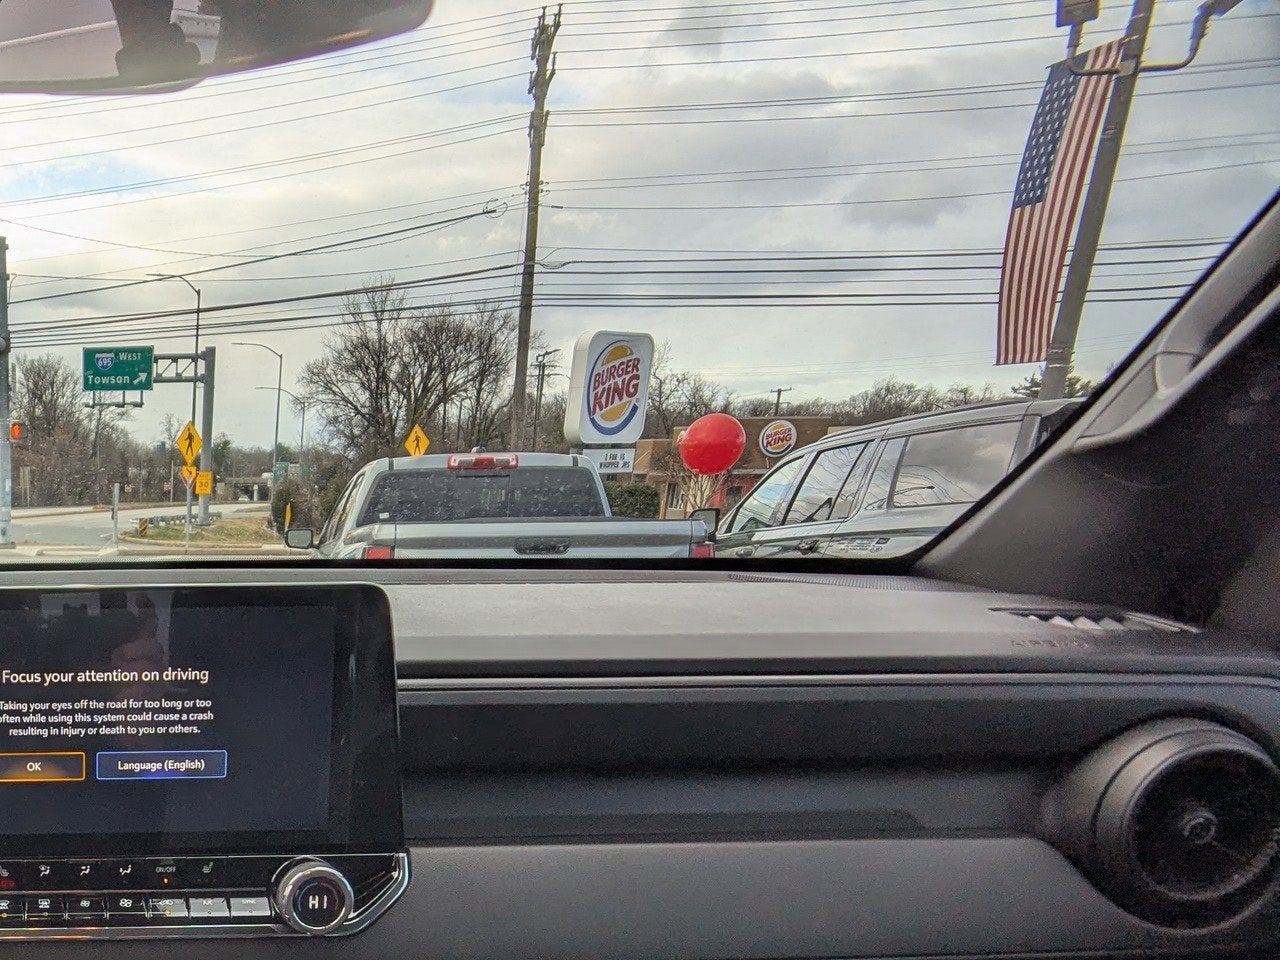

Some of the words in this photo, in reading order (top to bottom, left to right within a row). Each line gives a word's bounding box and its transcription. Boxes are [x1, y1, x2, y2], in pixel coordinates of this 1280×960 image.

[97, 357, 112, 367] 695
[87, 375, 130, 384] Towson
[592, 358, 640, 392] BURGER
[591, 373, 640, 417] KING
[765, 427, 792, 440] BURGER
[765, 433, 792, 448] KING
[198, 480, 209, 488] 30
[2, 669, 42, 684] Focus
[43, 672, 74, 686] your
[77, 668, 138, 682] attention
[142, 670, 160, 681] on
[162, 666, 210, 684] driving
[29, 702, 51, 712] your
[51, 702, 73, 712] eyes
[74, 699, 88, 710] off
[89, 699, 105, 709] the
[106, 699, 128, 709] road
[129, 699, 143, 708] for
[144, 699, 160, 708] too
[161, 698, 183, 710] long
[184, 700, 195, 708] or
[196, 698, 213, 708] too
[22, 713, 47, 723] while
[48, 714, 73, 725] using
[74, 712, 92, 722] this
[93, 712, 125, 724] system
[126, 711, 152, 721] could
[153, 712, 180, 721] cause
[181, 713, 188, 721] a
[188, 710, 215, 721] crash
[8, 726, 49, 738] resulting
[50, 726, 59, 736] in
[60, 726, 86, 738] injury
[87, 726, 98, 735] or
[99, 725, 126, 735] death
[127, 725, 137, 735] to
[138, 727, 155, 737] you
[156, 726, 168, 734] or
[168, 723, 202, 734] others.
[26, 761, 43, 772] OK
[117, 760, 163, 772] Language
[164, 759, 206, 772] (English)
[308, 896, 329, 909] HI
